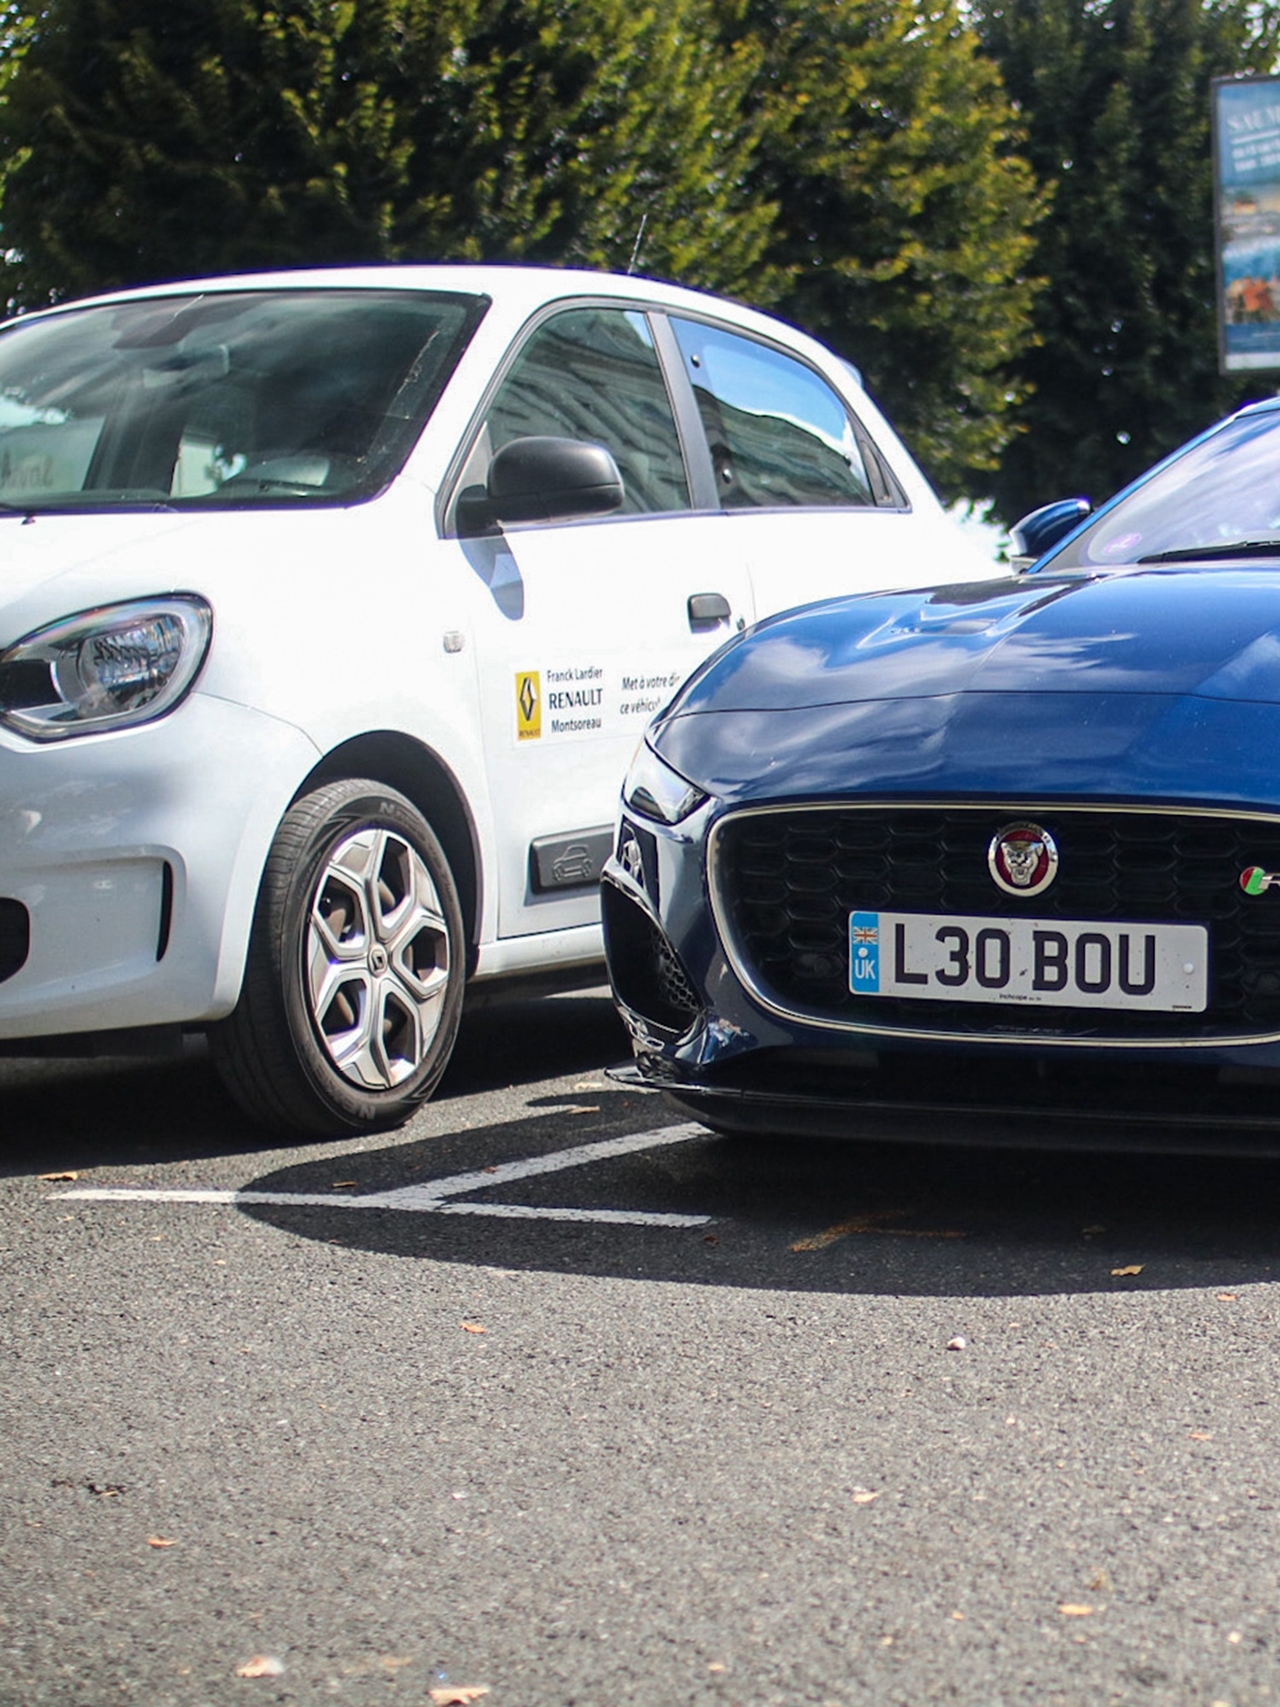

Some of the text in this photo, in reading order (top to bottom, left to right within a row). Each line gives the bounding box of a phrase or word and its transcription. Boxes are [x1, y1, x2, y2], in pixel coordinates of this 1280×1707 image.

[547, 666, 602, 682] Franck Lardier
[622, 677, 638, 690] Met
[647, 677, 667, 688] votre
[549, 688, 602, 710] RENAULT
[620, 703, 630, 714] ce
[551, 719, 602, 732] Montsoreau
[894, 923, 1156, 996] L30 BOU
[855, 959, 876, 979] UK
